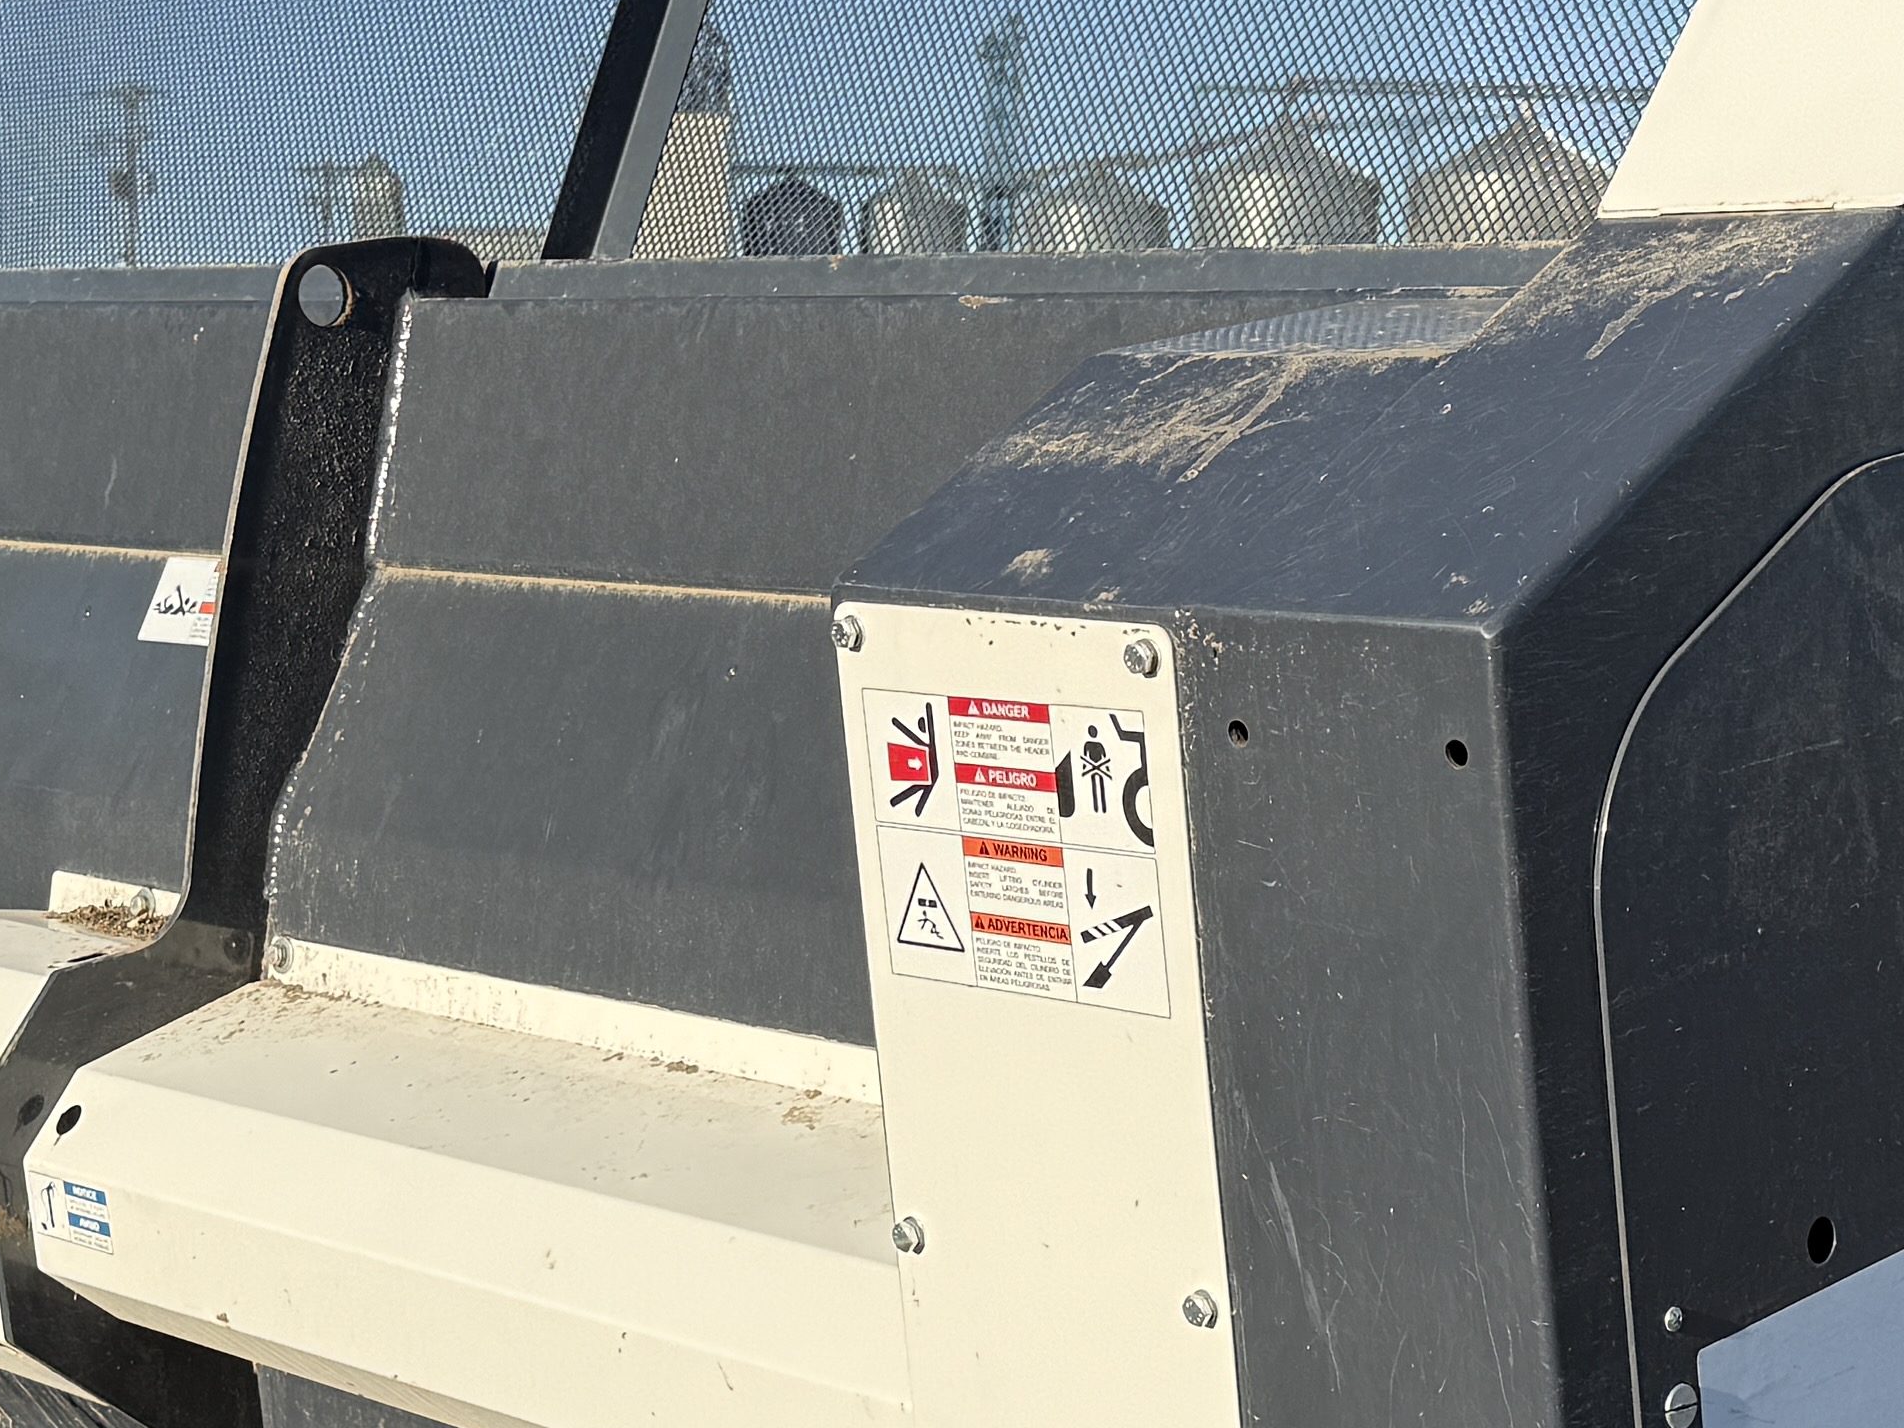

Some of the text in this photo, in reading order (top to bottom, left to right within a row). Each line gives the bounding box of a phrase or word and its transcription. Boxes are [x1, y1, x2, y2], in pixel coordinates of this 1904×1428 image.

[982, 702, 1029, 719] DANGER
[988, 769, 1037, 787] PELIGRO
[993, 843, 1047, 861] WARNING
[988, 918, 1068, 941] ADVERTENCIA
